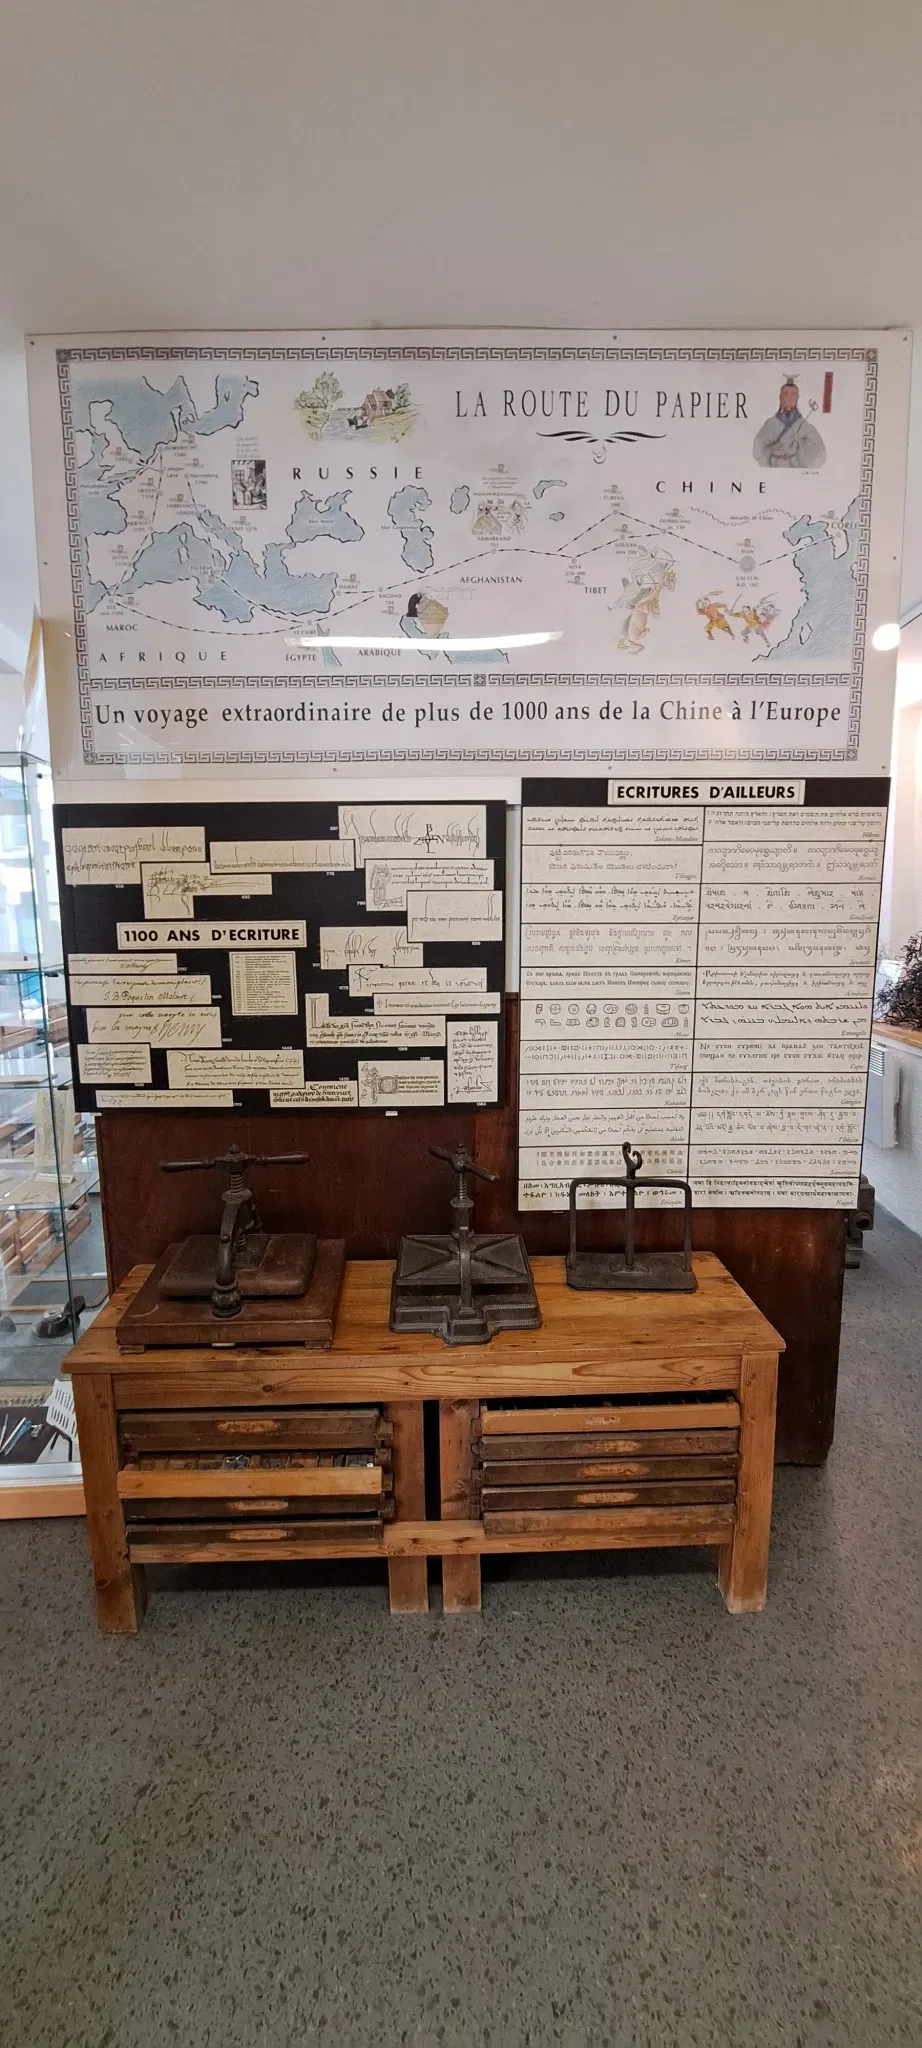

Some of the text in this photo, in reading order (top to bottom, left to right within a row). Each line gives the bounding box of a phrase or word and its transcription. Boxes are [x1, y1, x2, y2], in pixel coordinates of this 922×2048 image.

[456, 390, 747, 418] LA ROUTE DU PAPIER
[293, 467, 421, 479] RUSSIE
[656, 481, 765, 493] CHINE
[106, 623, 139, 632] MAROC
[100, 652, 226, 663] AFRIQUE
[285, 652, 317, 662] ÉGYPTE
[95, 701, 840, 729] Un voyage extraordinaire de plus de 1000 ans de la Chine à l'Europe
[618, 786, 794, 798] ECRITURES D'AILLEURS
[124, 929, 299, 941] 1100 ANS D'ECRITURE
